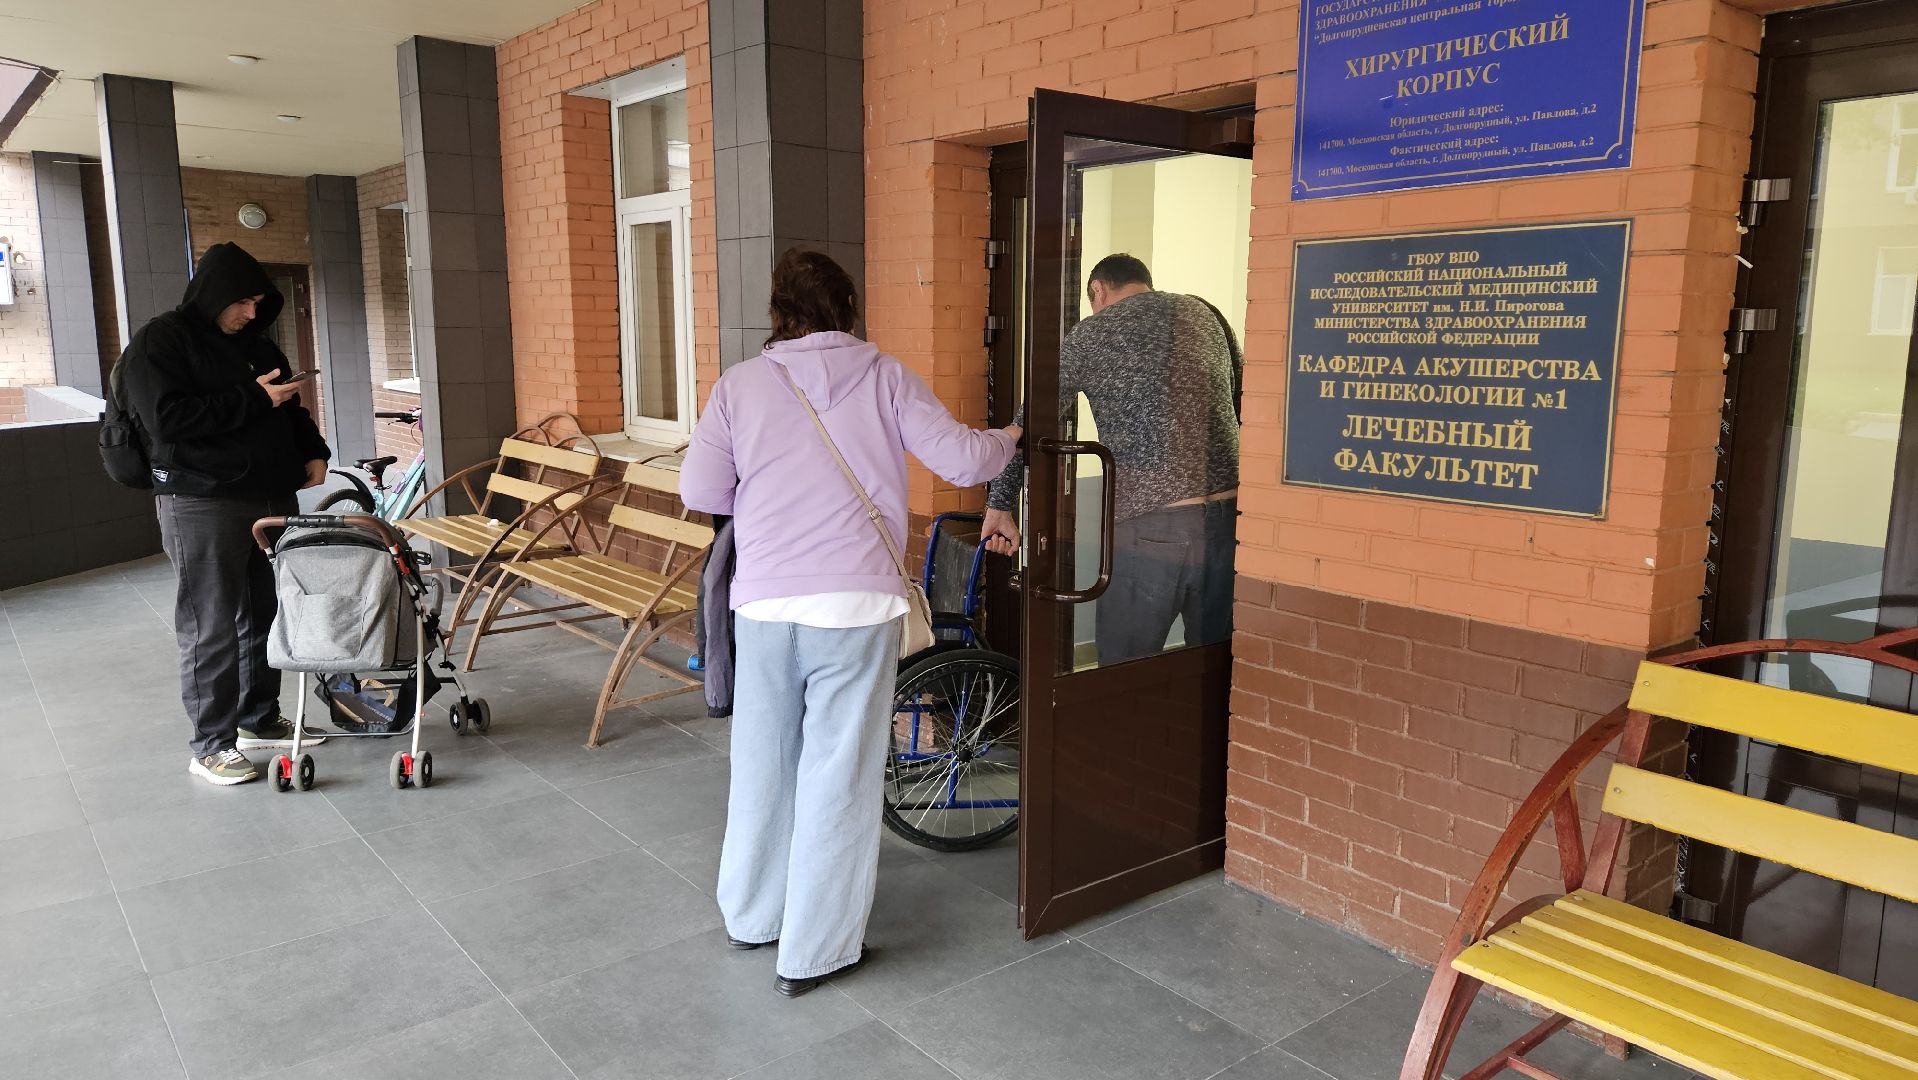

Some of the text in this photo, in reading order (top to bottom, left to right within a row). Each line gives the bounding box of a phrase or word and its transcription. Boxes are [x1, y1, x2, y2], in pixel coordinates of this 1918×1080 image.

[1410, 1, 1481, 23] центральная
[1344, 12, 1571, 80] ХИРУРГИЧЕСКИЙ
[1396, 62, 1501, 98] КОРПУС
[1348, 134, 1395, 145] Московская
[1397, 128, 1432, 140] область,
[1441, 116, 1513, 134] Долгопрудный,
[1515, 115, 1530, 126] ул.
[1532, 108, 1579, 120] Павлова,
[1390, 103, 1504, 128] Юридический адрес:
[1346, 162, 1393, 173] Московская
[1395, 157, 1431, 168] область,
[1440, 146, 1511, 163] Долгопрудный,
[1512, 146, 1527, 156] ул.
[1530, 140, 1577, 152] Павлова,
[1390, 135, 1499, 156] Фактический адрес:
[1407, 250, 1480, 266] ГБОУ ВПО
[1332, 261, 1568, 284] РОССИЙСКИЙ НАЦИОНАЛЬНЫЙ
[1309, 278, 1599, 300] ИССЛЕДОВАТЕЛЬСКИЙ МЕДИЦИНСКИЙ
[1332, 299, 1566, 314] УНИВЕРСИТЕТ им. Н.И. Пирогова
[1314, 315, 1588, 331] МИНИСТЕРСТВА ЗДРАВООХРАНЕНИЯ
[1346, 330, 1541, 348] РОССИЙСКОЙ ФЕДЕРАЦИИ
[1298, 354, 1603, 381] КАФЕДРА АКУШЕРСТВА
[1319, 380, 1568, 410] И ГИНЕКОЛОГИИ №1
[1342, 414, 1533, 451] ЛЕЧЕБНЫЙ
[1334, 448, 1539, 490] ФАКУЛЬТЕТ
